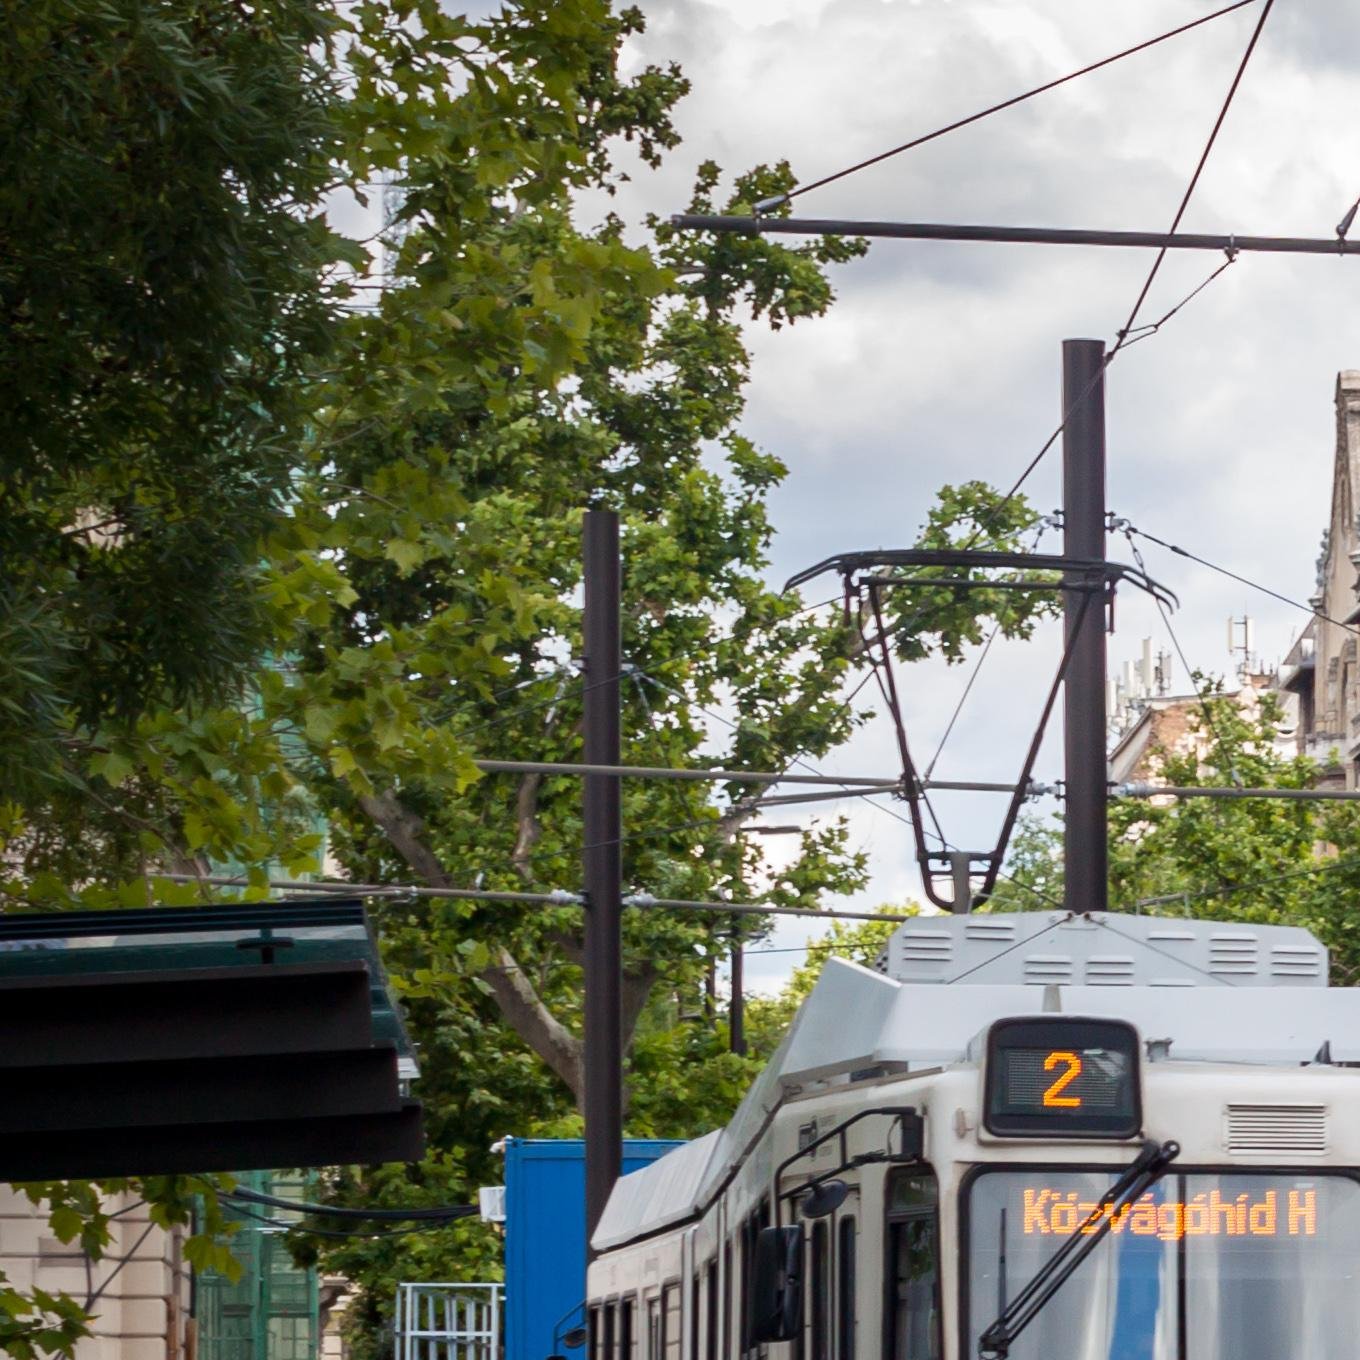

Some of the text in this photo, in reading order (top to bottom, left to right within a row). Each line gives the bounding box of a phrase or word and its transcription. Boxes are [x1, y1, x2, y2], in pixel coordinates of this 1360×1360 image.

[1043, 1052, 1082, 1107] 2
[1023, 1188, 1317, 1241] Közvágóhíd H
